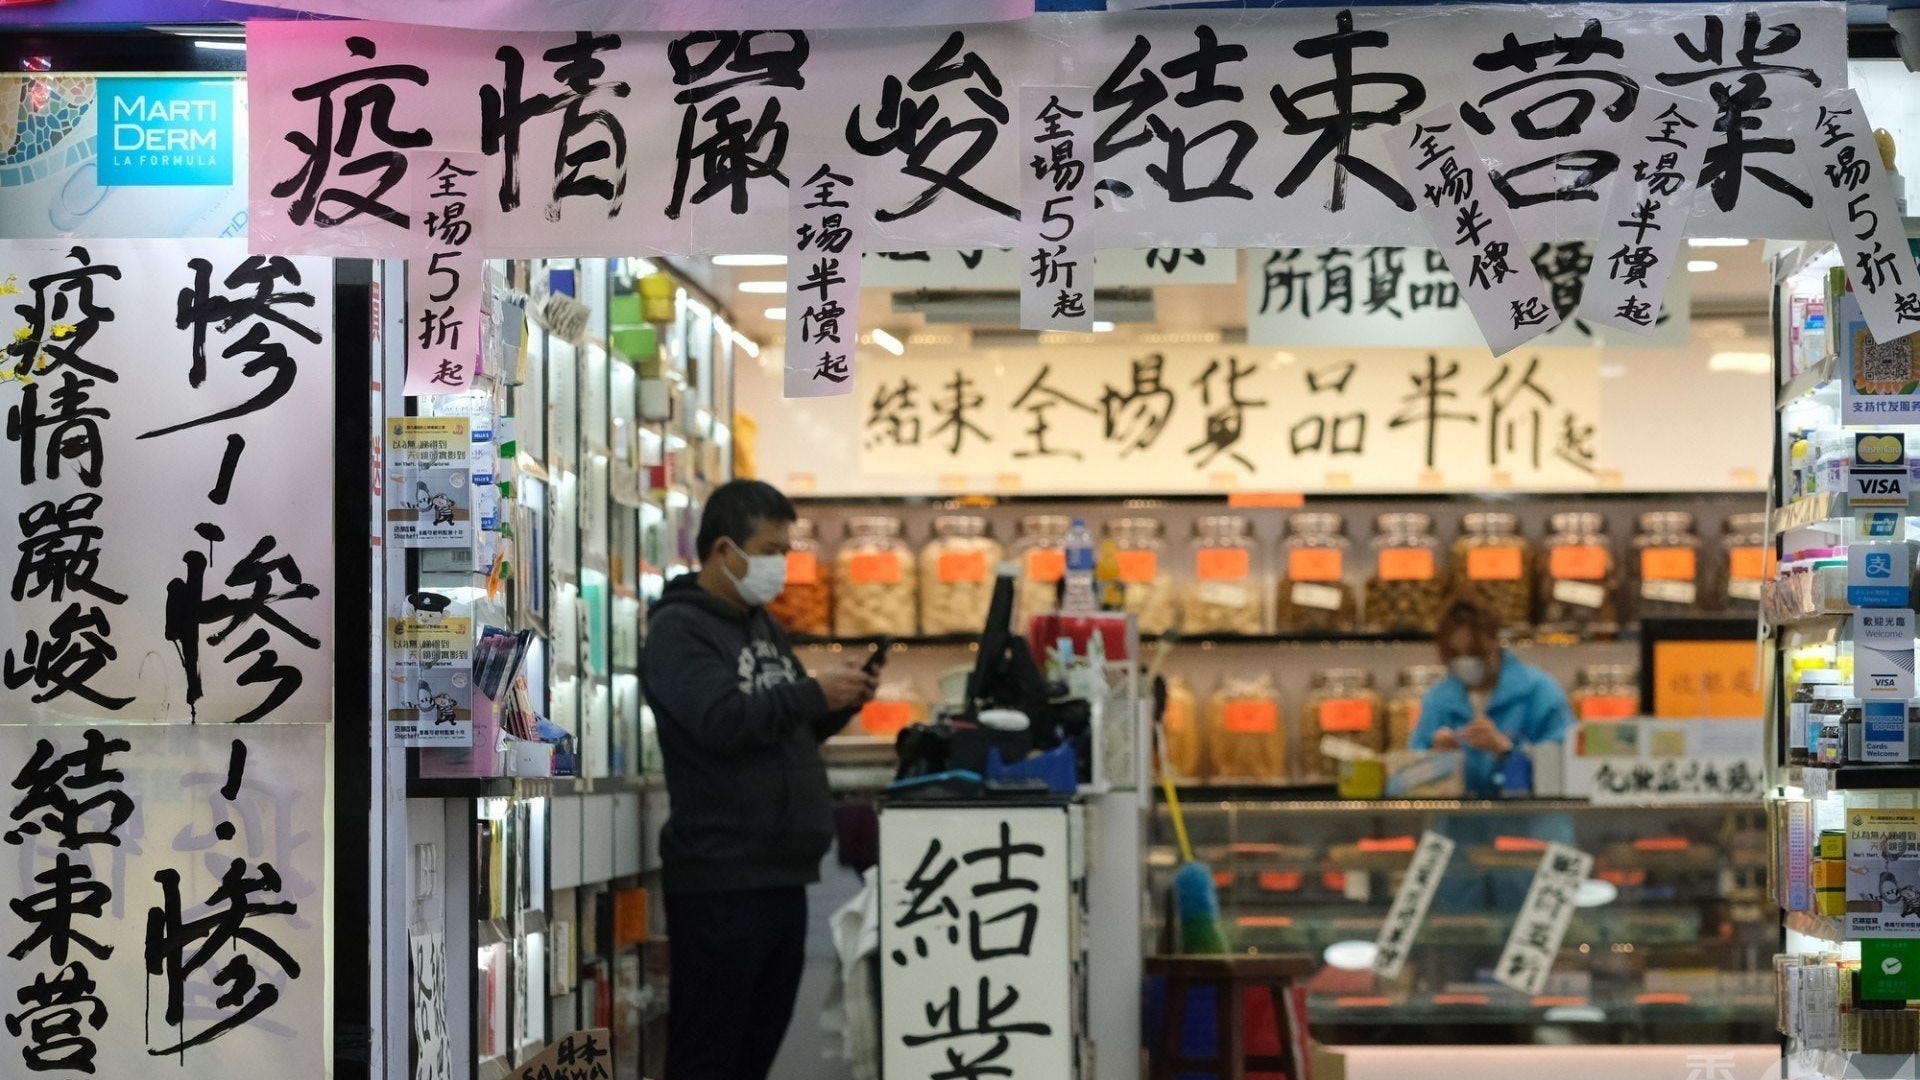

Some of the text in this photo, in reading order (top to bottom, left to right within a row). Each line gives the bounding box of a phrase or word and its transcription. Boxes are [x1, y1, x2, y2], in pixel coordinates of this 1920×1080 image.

[114, 96, 216, 121] MARTI
[114, 125, 216, 150] DERM
[114, 156, 217, 165] LA FORMULA
[1856, 479, 1901, 494] VISA
[1865, 630, 1903, 638] Welcome
[1875, 678, 1896, 687] VISA
